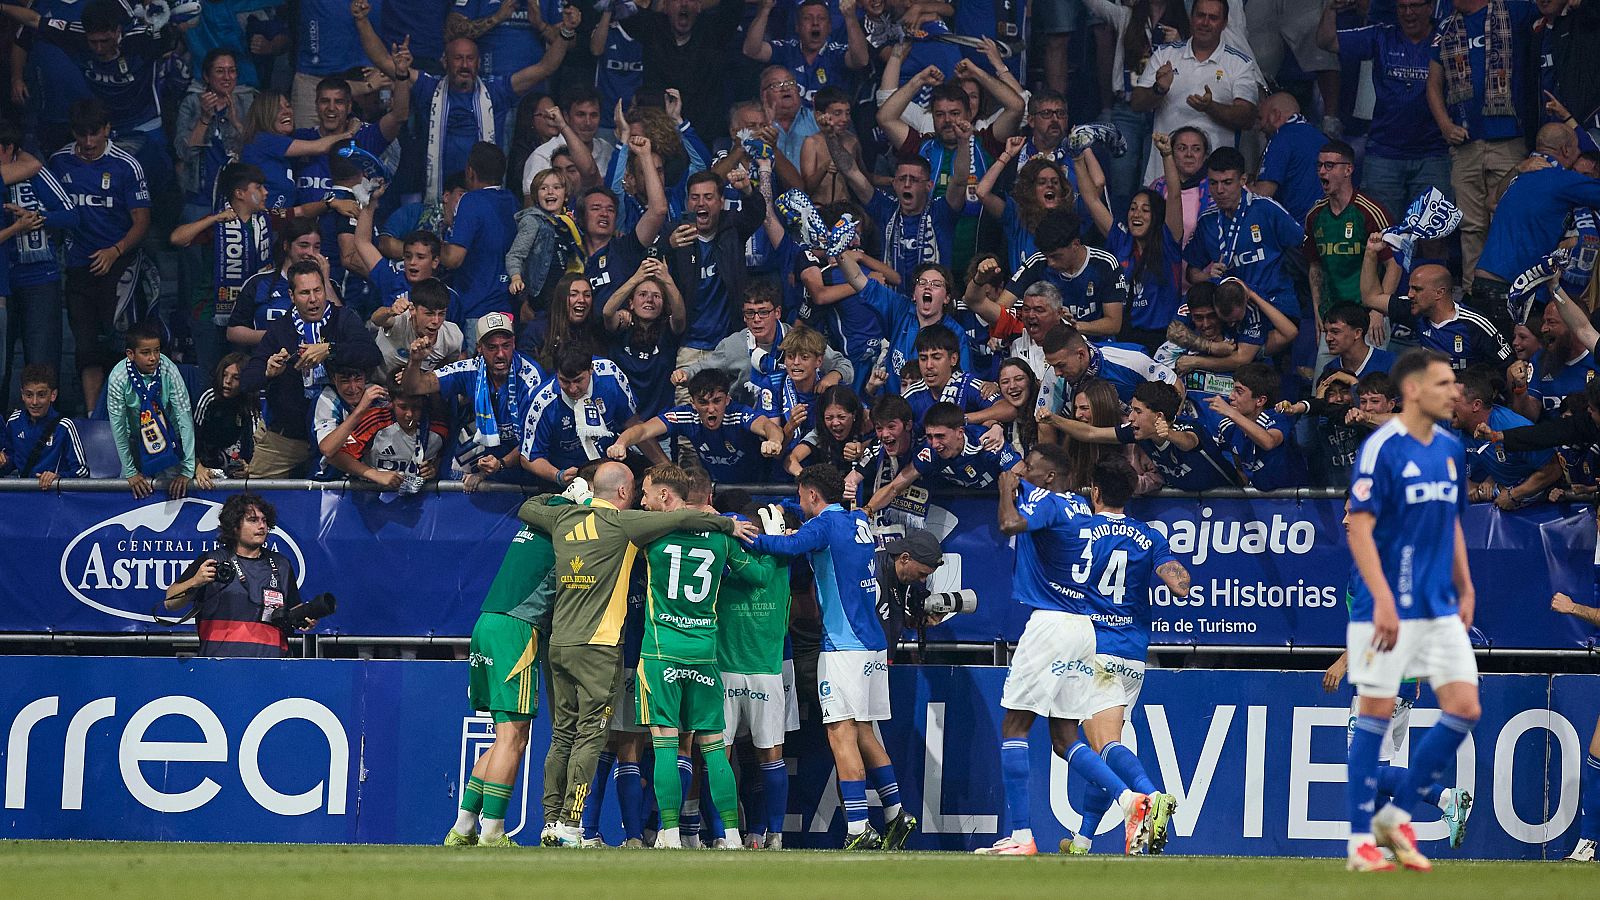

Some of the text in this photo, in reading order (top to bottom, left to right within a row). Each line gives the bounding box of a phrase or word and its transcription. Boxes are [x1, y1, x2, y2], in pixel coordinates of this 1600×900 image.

[638, 351, 650, 360] 32
[116, 539, 195, 553] CENTRAL
[1111, 524, 1153, 551] COSTAS
[1071, 528, 1093, 584] 3
[662, 543, 716, 603] 13
[1097, 549, 1128, 605] 4
[1210, 578, 1338, 609] Historias
[1174, 618, 1194, 633] de
[1197, 618, 1258, 634] Turismo
[674, 668, 715, 687] DEXTOOLS
[4, 695, 350, 816] rrea
